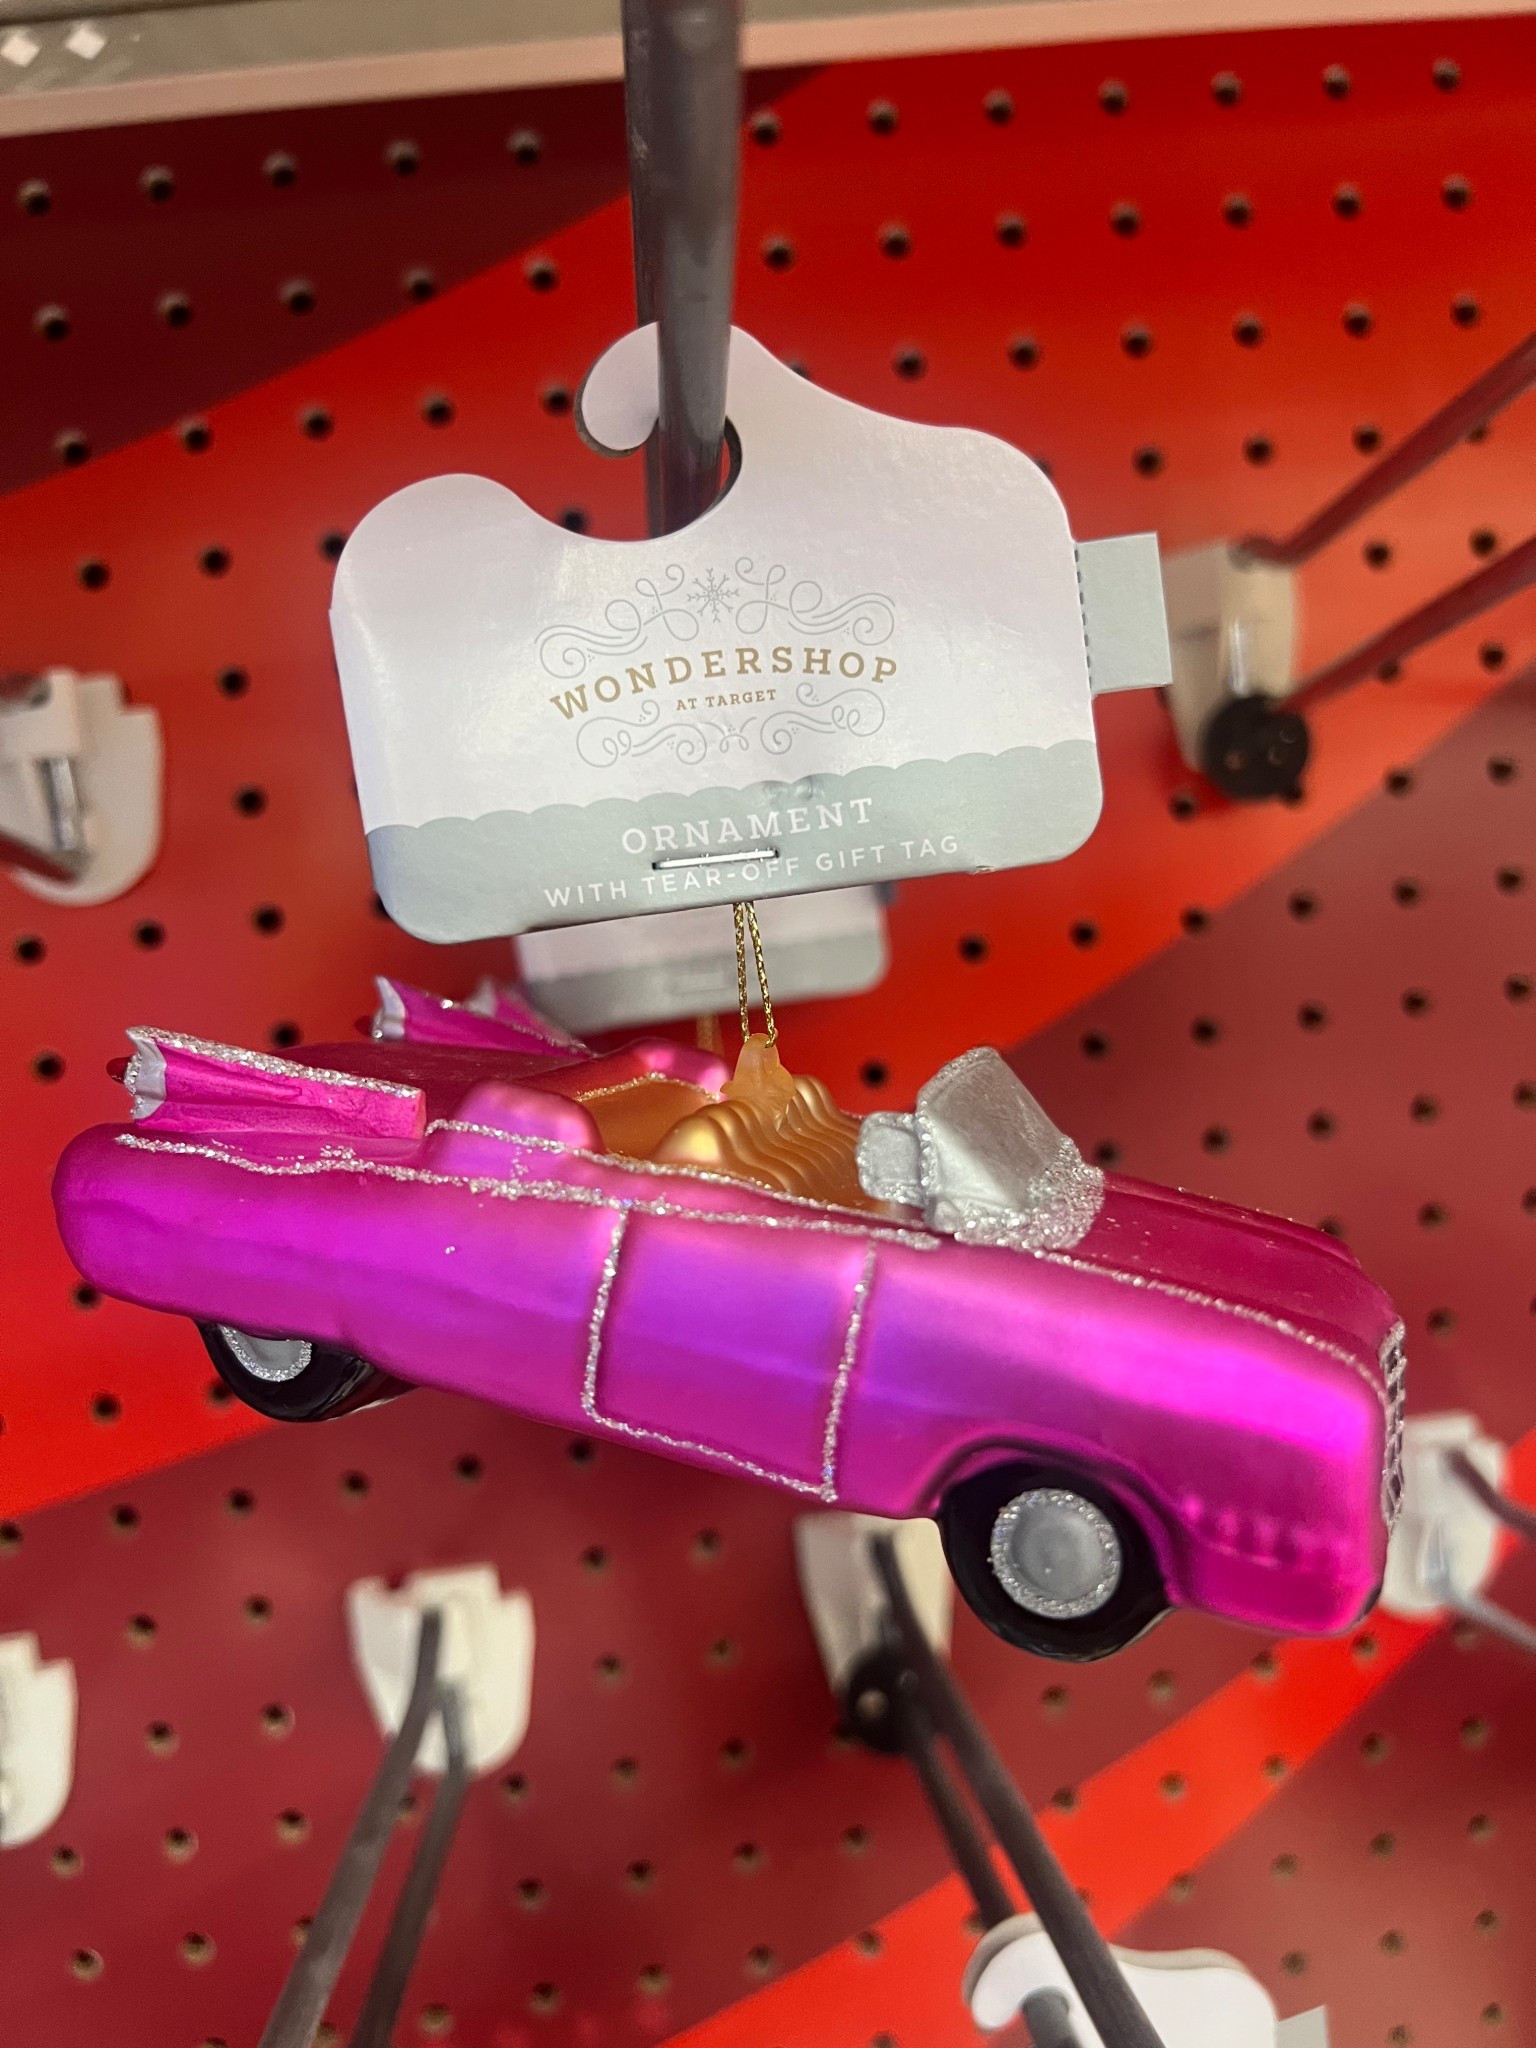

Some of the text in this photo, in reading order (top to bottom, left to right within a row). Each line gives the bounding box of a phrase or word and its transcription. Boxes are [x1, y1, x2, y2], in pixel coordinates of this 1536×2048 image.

[549, 646, 898, 721] WONDERSHOP
[676, 688, 778, 711] AT TARGET
[622, 797, 873, 854] ORNAMENT
[544, 835, 959, 908] WITH TEAR-OFF GIFT TAG
